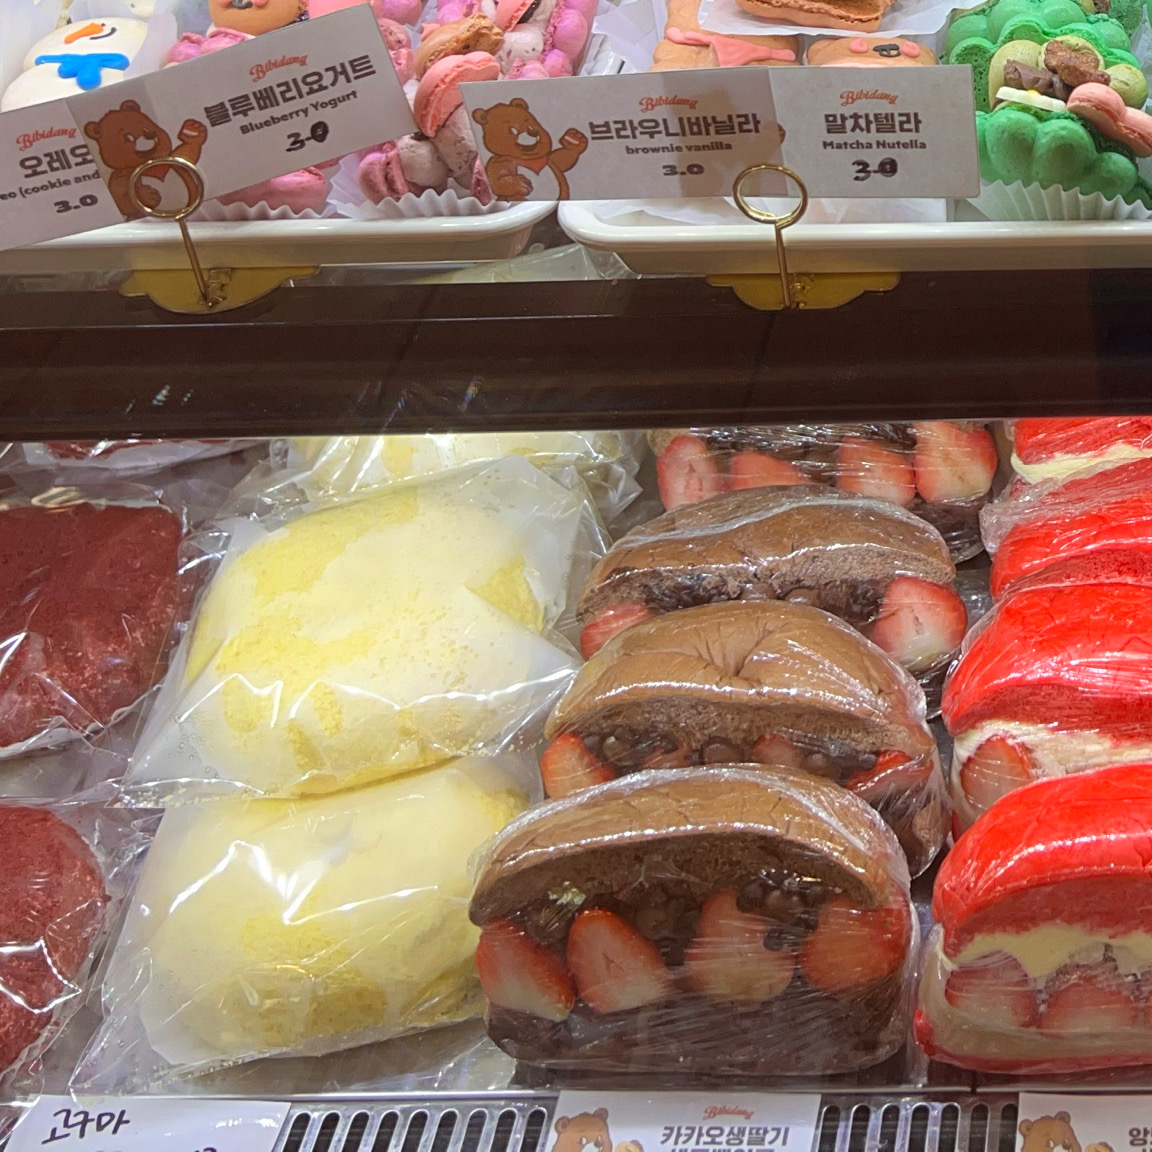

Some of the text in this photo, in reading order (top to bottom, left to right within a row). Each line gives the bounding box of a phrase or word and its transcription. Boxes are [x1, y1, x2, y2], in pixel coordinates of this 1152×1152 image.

[249, 54, 309, 83] Bibidang
[203, 54, 377, 127] 블루베리요거트
[840, 89, 899, 106] Bibidang
[239, 90, 358, 135] Blueberry Yogurt
[638, 94, 699, 113] Bibidang
[588, 113, 761, 140] 브라우니바닐라
[824, 112, 922, 134] 말차텔라
[16, 126, 78, 151] Bibidang
[626, 141, 733, 155] brownie vanilla
[822, 139, 927, 150] Matcha Nutella
[19, 144, 95, 178] 오레오
[662, 163, 705, 176] 3.0
[18, 177, 72, 199] (cookie
[73, 169, 102, 184] and
[54, 194, 98, 214] 3.0
[41, 1108, 130, 1145] 고구마
[660, 1125, 790, 1146] 카카오생딸기
